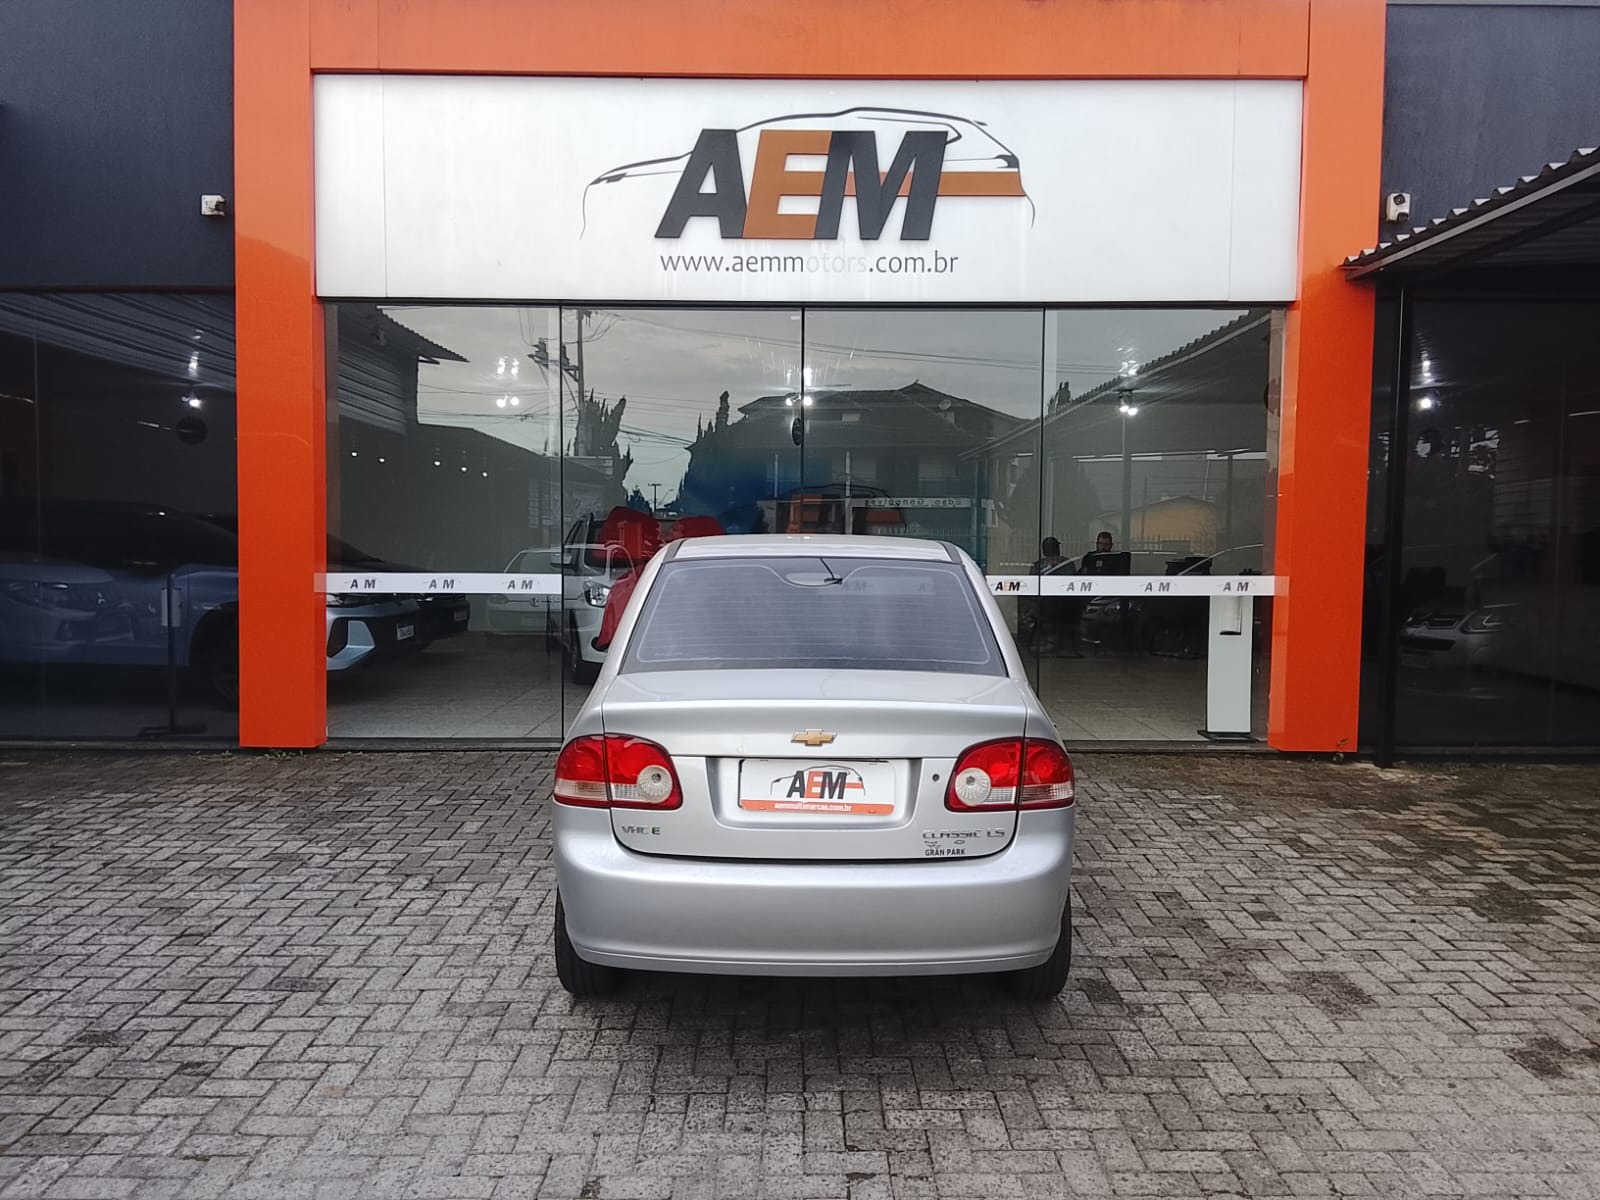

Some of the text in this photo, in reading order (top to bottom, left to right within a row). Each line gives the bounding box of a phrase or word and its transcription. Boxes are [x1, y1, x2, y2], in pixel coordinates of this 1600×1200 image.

[654, 128, 948, 241] AEM
[660, 250, 959, 274] www.aemmotors.com.br
[786, 770, 848, 799] AEM
[922, 828, 1006, 839] CLASSIC LS
[925, 848, 966, 857] GRAN PARK
